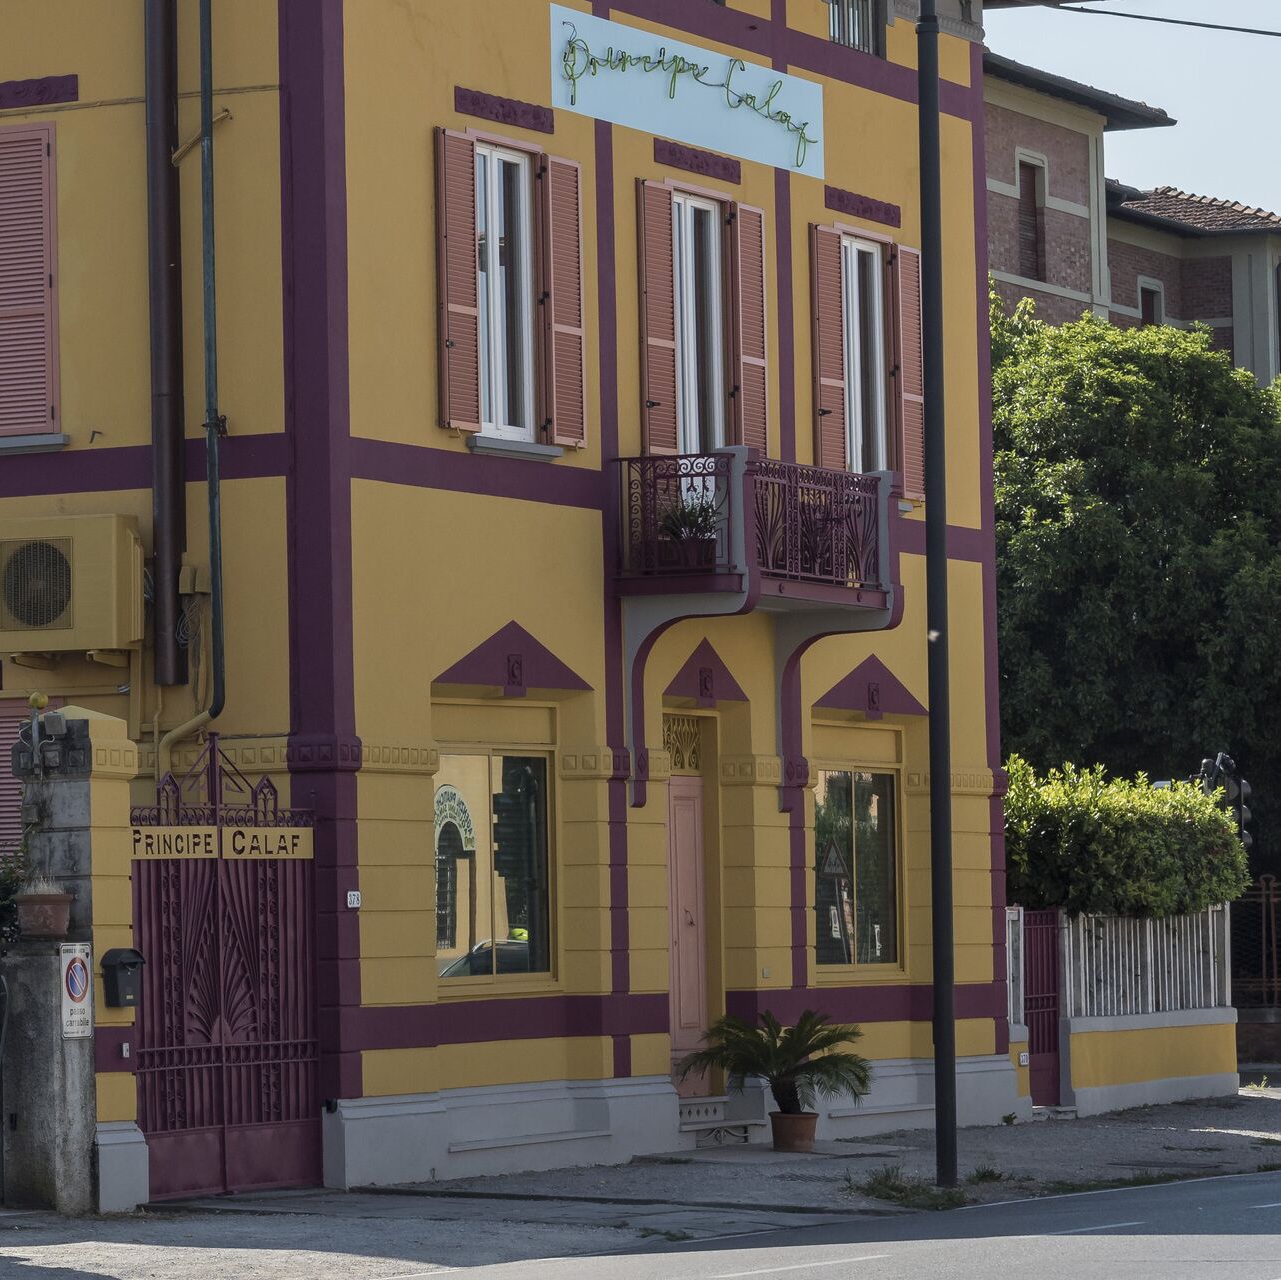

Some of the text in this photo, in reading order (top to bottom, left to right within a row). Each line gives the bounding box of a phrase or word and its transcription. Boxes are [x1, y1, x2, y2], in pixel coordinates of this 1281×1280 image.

[563, 38, 819, 168] Principe Calaf
[132, 829, 300, 855] PRINCIPE CALAF
[69, 1007, 86, 1017] passo
[65, 1017, 90, 1027] carrabile
